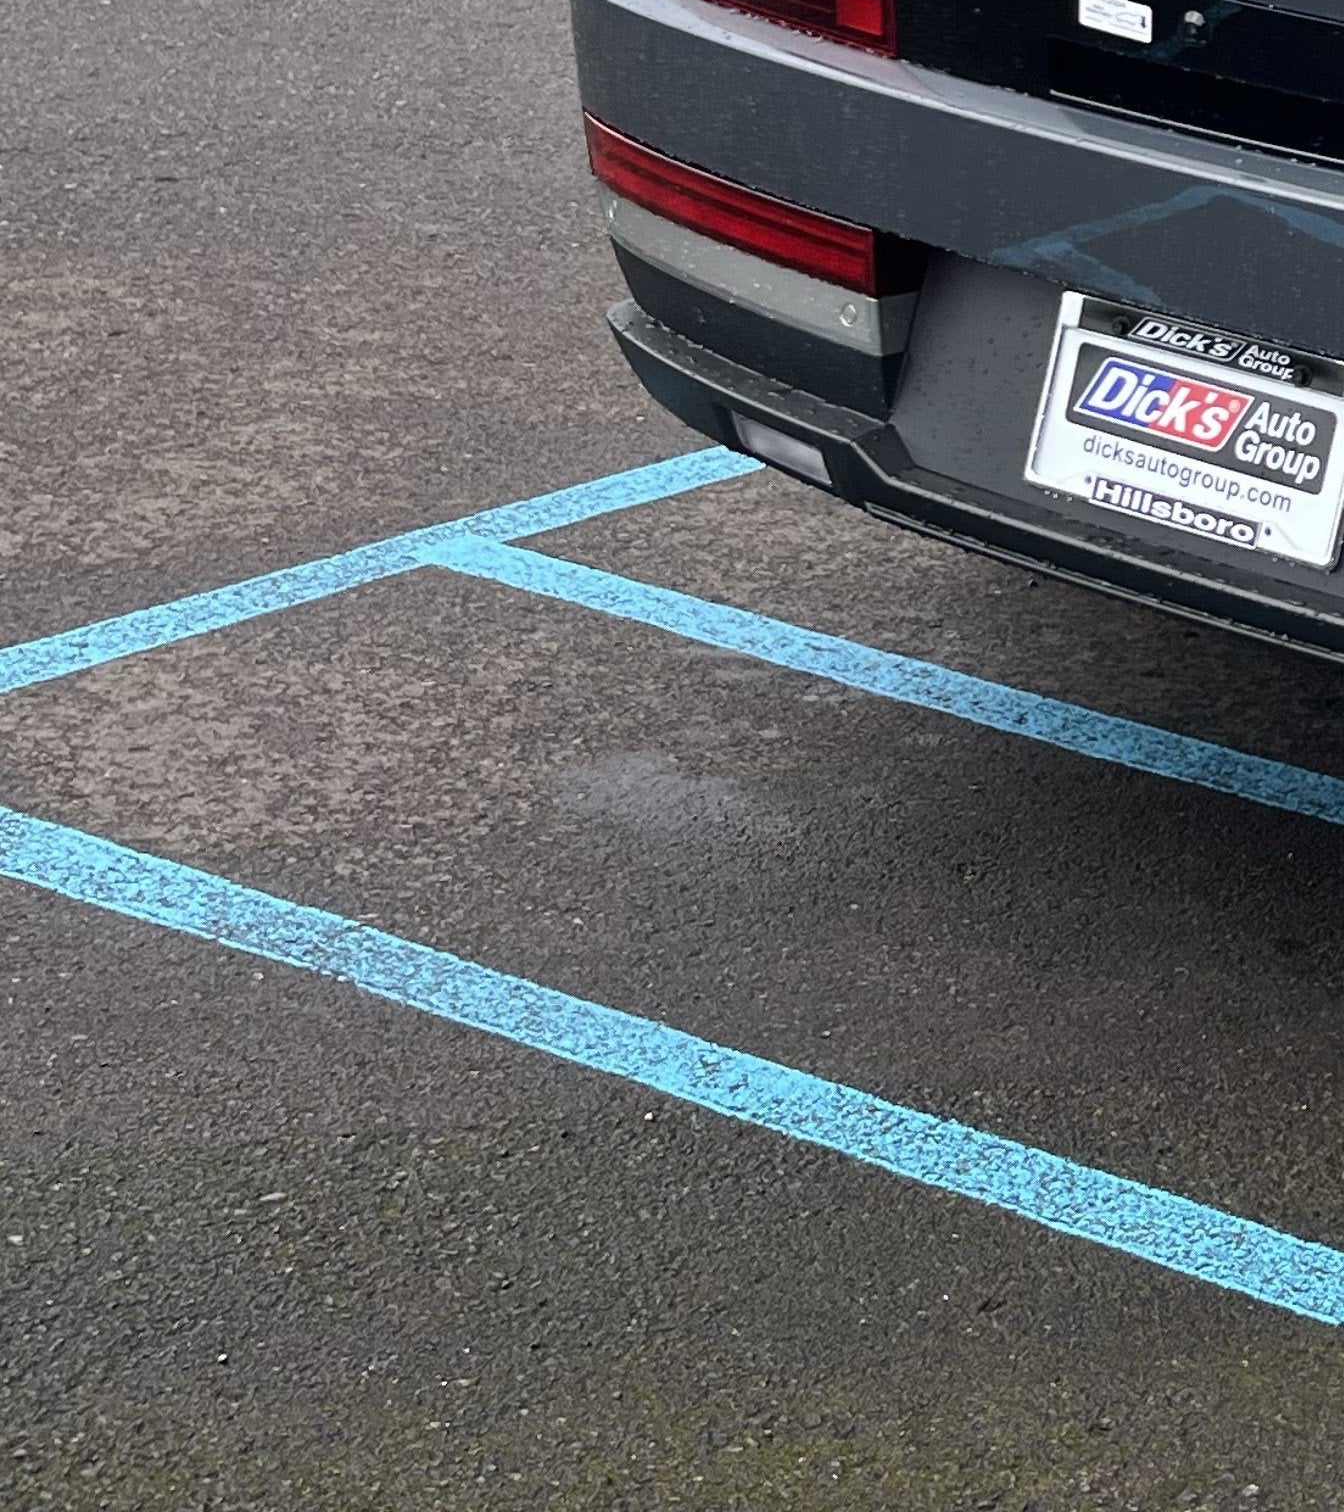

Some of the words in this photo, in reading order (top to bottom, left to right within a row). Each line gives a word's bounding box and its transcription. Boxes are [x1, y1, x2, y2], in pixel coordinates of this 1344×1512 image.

[1137, 319, 1234, 360] Dick's
[1246, 344, 1292, 365] Auto
[1087, 364, 1231, 440] Dick's
[1245, 402, 1317, 446] Auto
[1083, 434, 1292, 513] dicksautogroup.com
[1234, 430, 1322, 485] Group
[1094, 478, 1256, 544] Hillsboro
